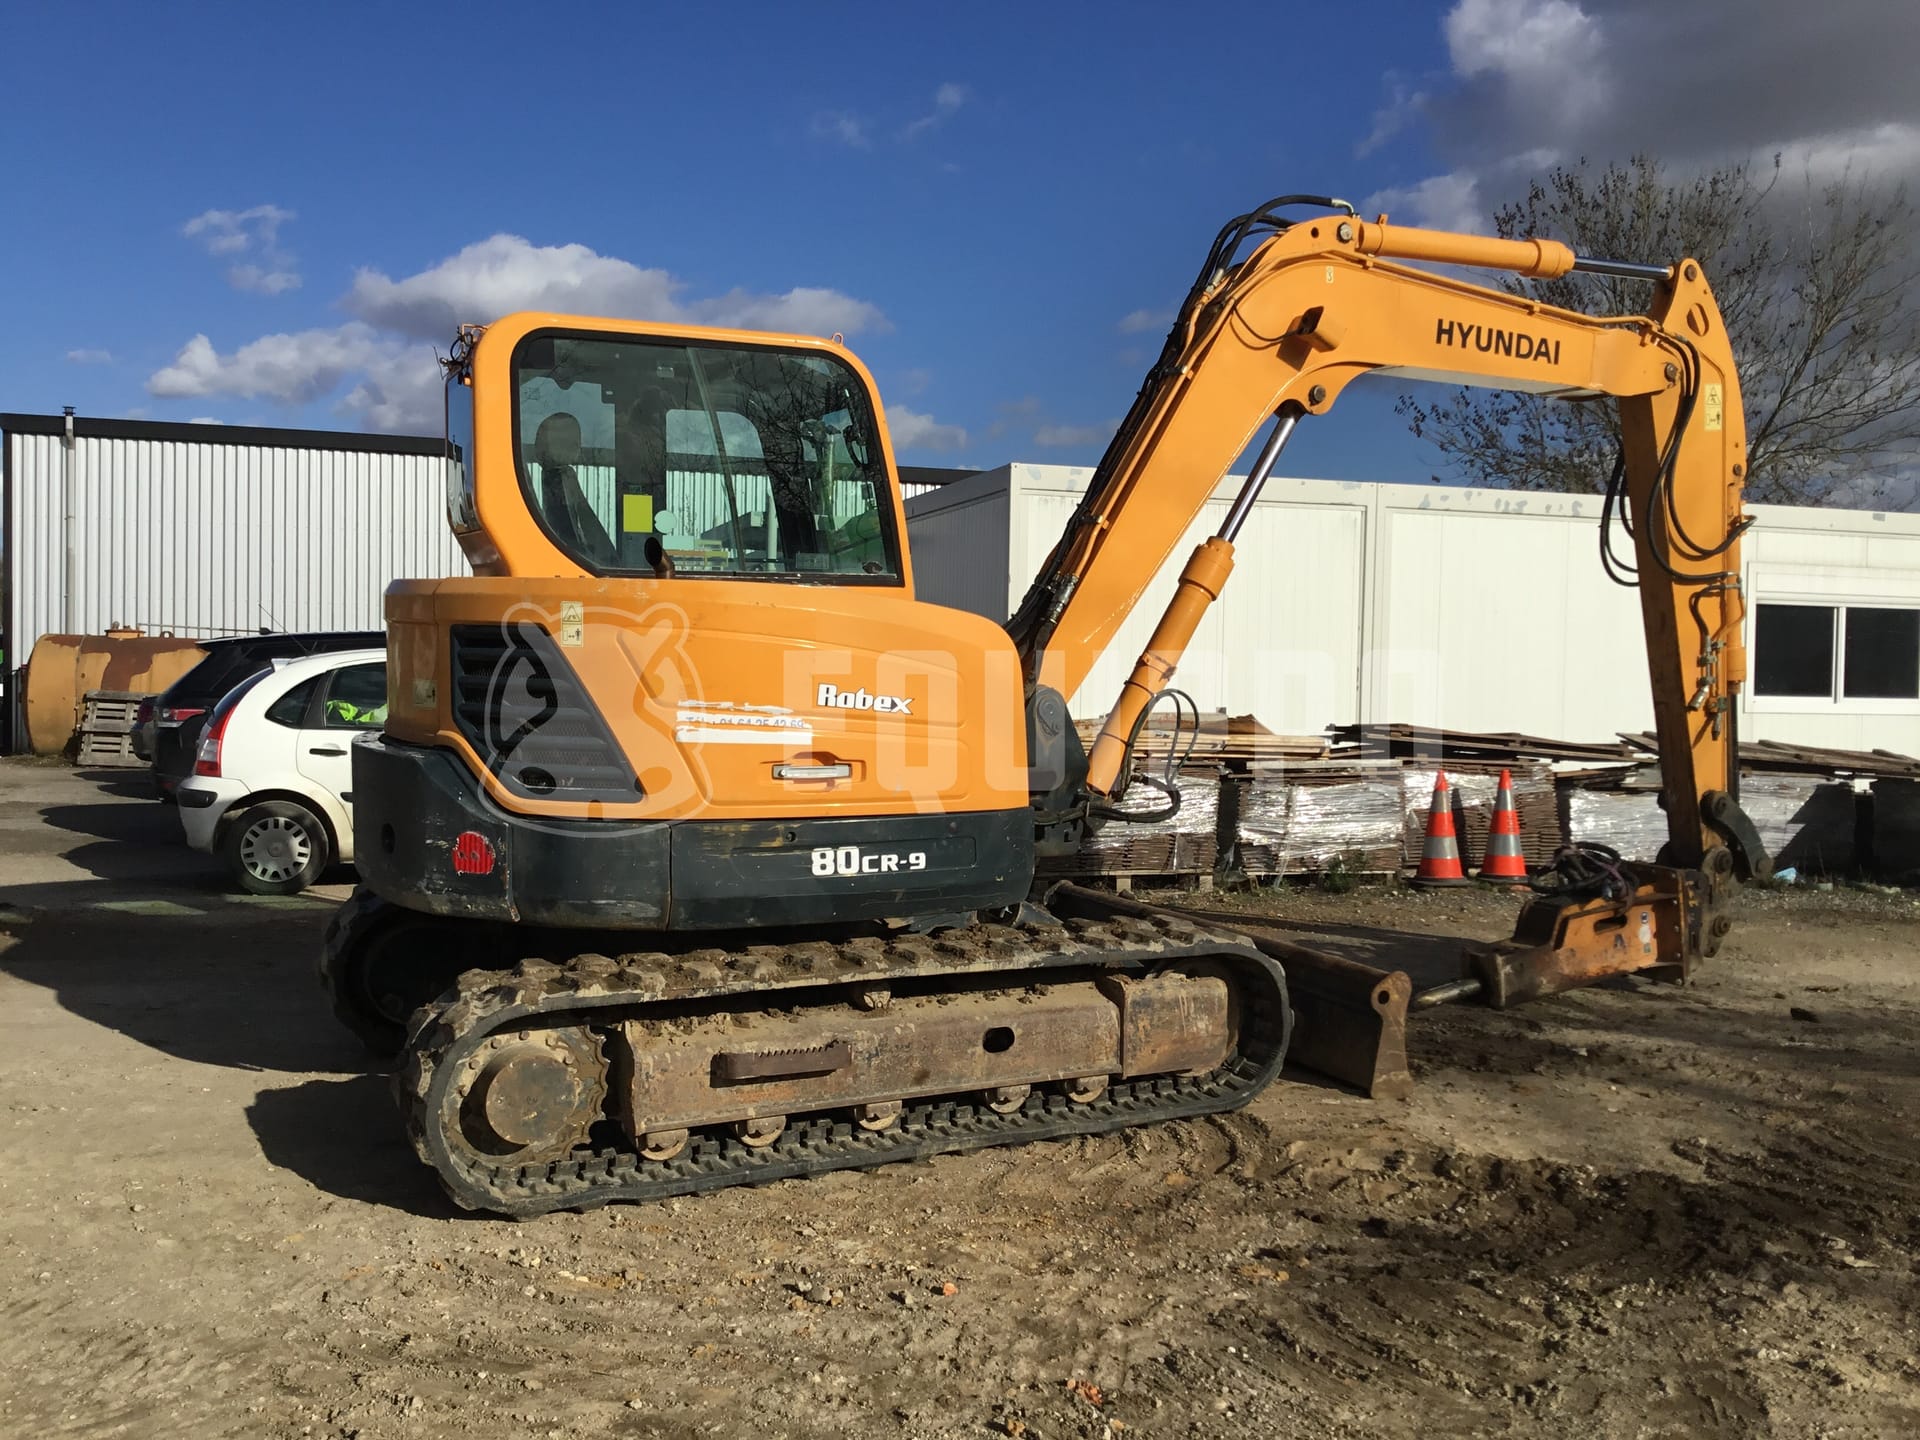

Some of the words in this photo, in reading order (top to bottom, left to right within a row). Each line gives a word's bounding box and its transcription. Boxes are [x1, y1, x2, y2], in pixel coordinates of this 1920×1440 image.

[1435, 318, 1561, 366] HYUNDAI
[817, 682, 914, 715] Robex
[811, 846, 926, 876] 80CR-9
